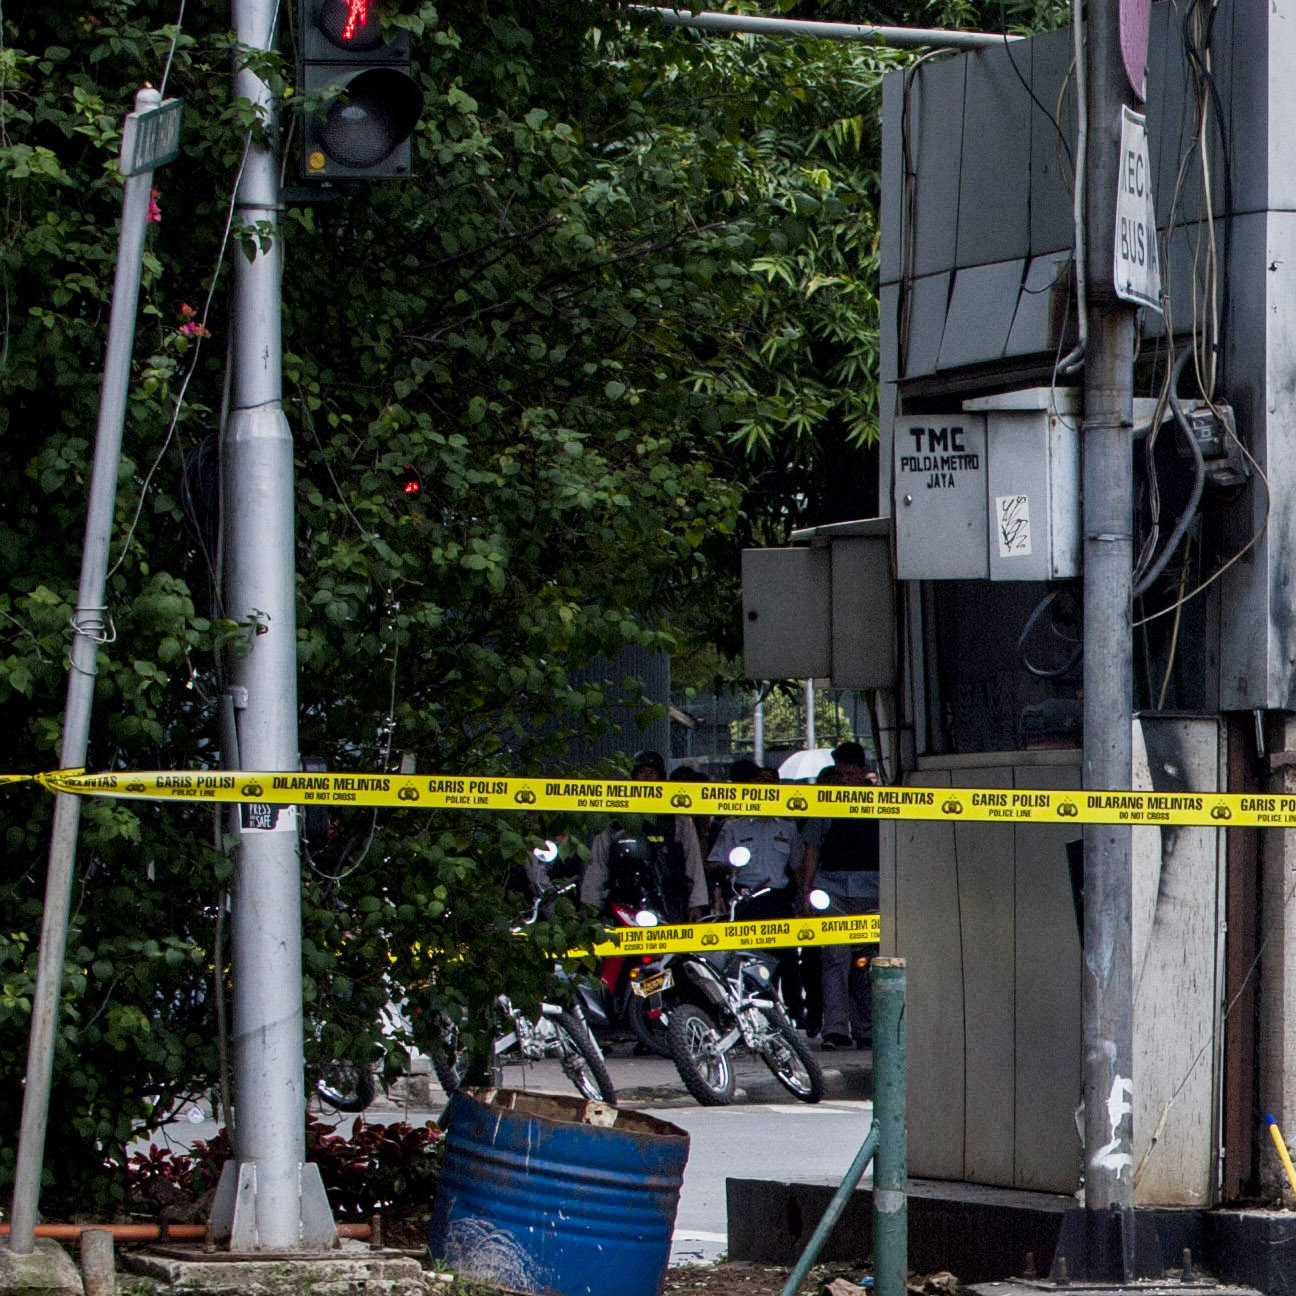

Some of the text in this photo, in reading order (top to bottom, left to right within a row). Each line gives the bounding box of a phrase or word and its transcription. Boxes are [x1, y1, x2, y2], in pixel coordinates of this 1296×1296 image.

[910, 427, 965, 453] TMC
[927, 473, 955, 489] JAYA
[156, 775, 235, 790] GARIS POLISI
[272, 776, 390, 791] DILARANG MELINTAS
[428, 779, 508, 795] GARIS POLISI
[546, 783, 664, 799] DILARANG MELINTAS
[700, 787, 780, 802] GARIS POLISI
[818, 789, 934, 805] DILARANG MELINTAS
[972, 793, 1050, 807] GARIS POLISI
[1088, 795, 1202, 810] DILARANG MELINTAS
[1240, 798, 1276, 812] GARIS
